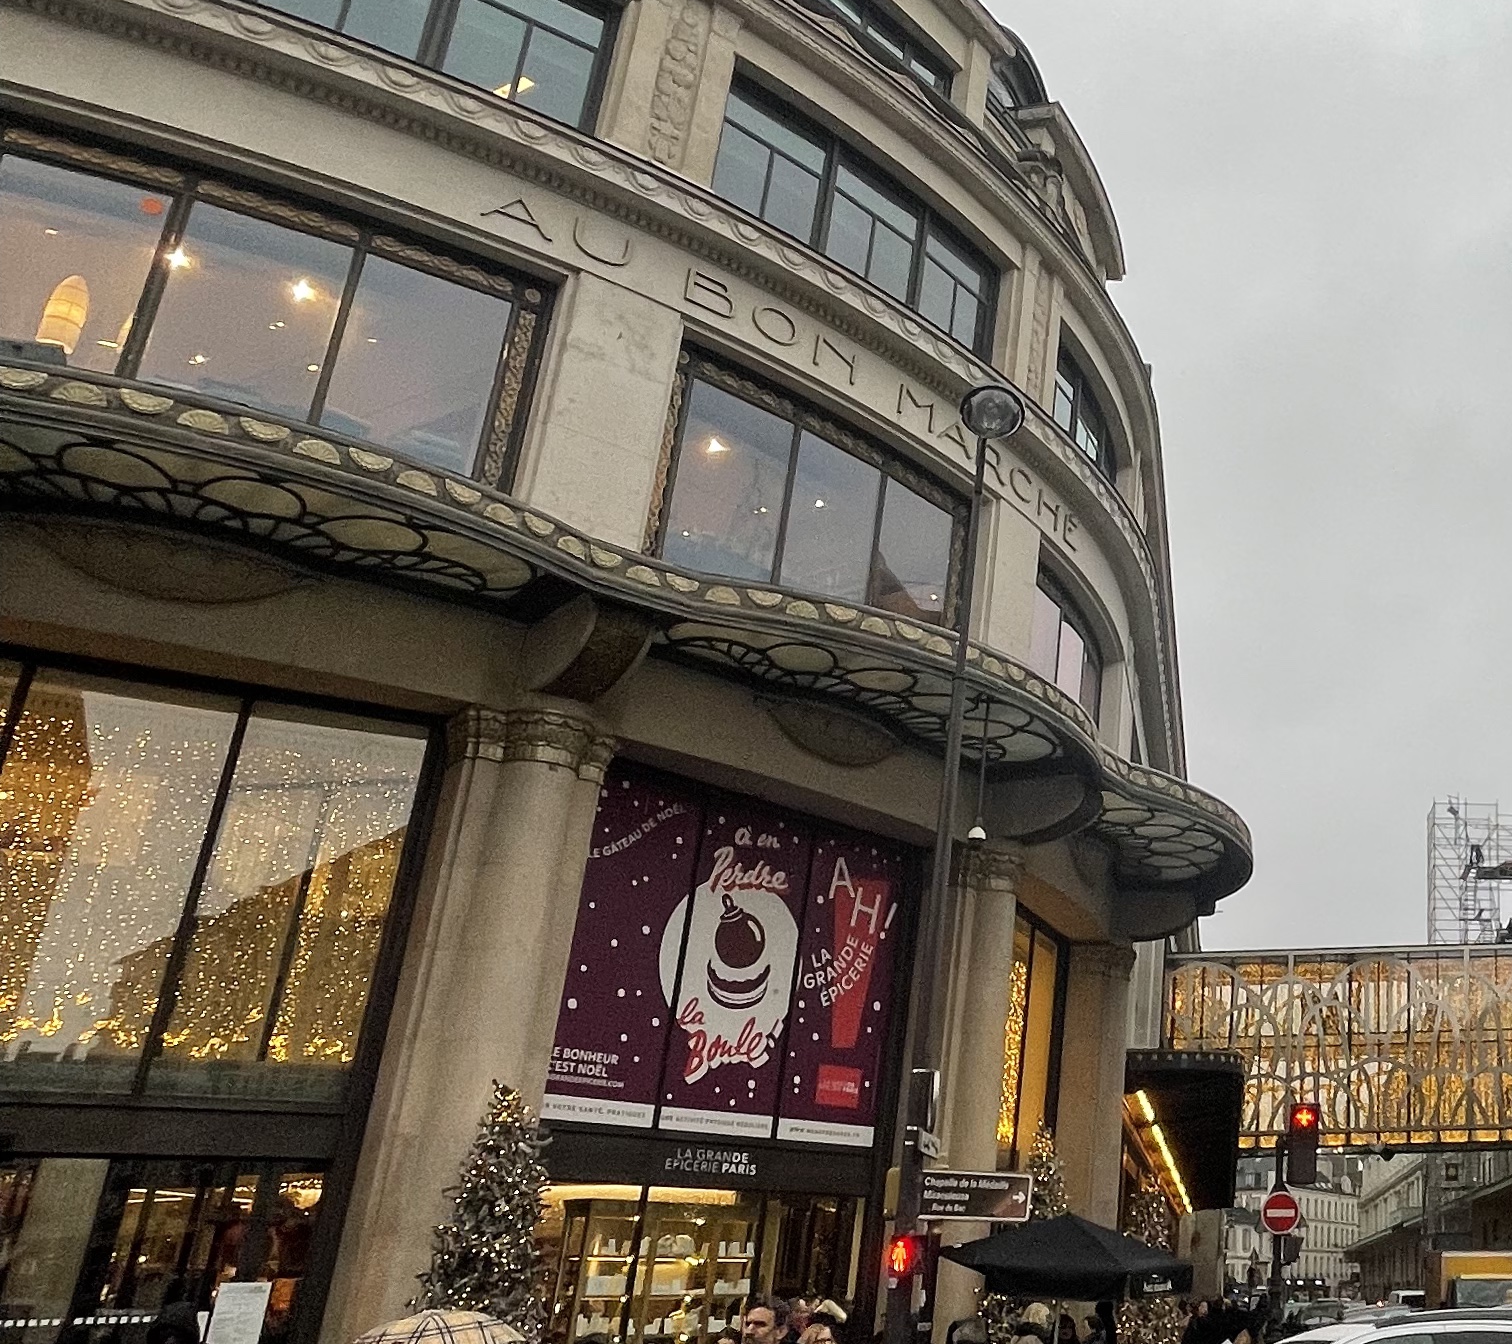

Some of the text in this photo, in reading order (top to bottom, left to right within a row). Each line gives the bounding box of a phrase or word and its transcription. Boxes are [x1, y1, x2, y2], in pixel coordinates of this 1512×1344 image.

[480, 197, 631, 267] AU
[682, 266, 856, 386] BON
[602, 827, 643, 856] GÂTEAU
[641, 817, 658, 833] DE
[712, 845, 790, 893] Perdre
[802, 934, 859, 990] GRANDE
[811, 947, 833, 969] LA
[819, 940, 875, 1008] ÉPICERIE
[679, 997, 705, 1026] la
[563, 1047, 620, 1065] BONHEUR
[577, 1062, 609, 1078] NOËL
[677, 1147, 750, 1164] LA GRANDE
[721, 1162, 757, 1176] PARIS
